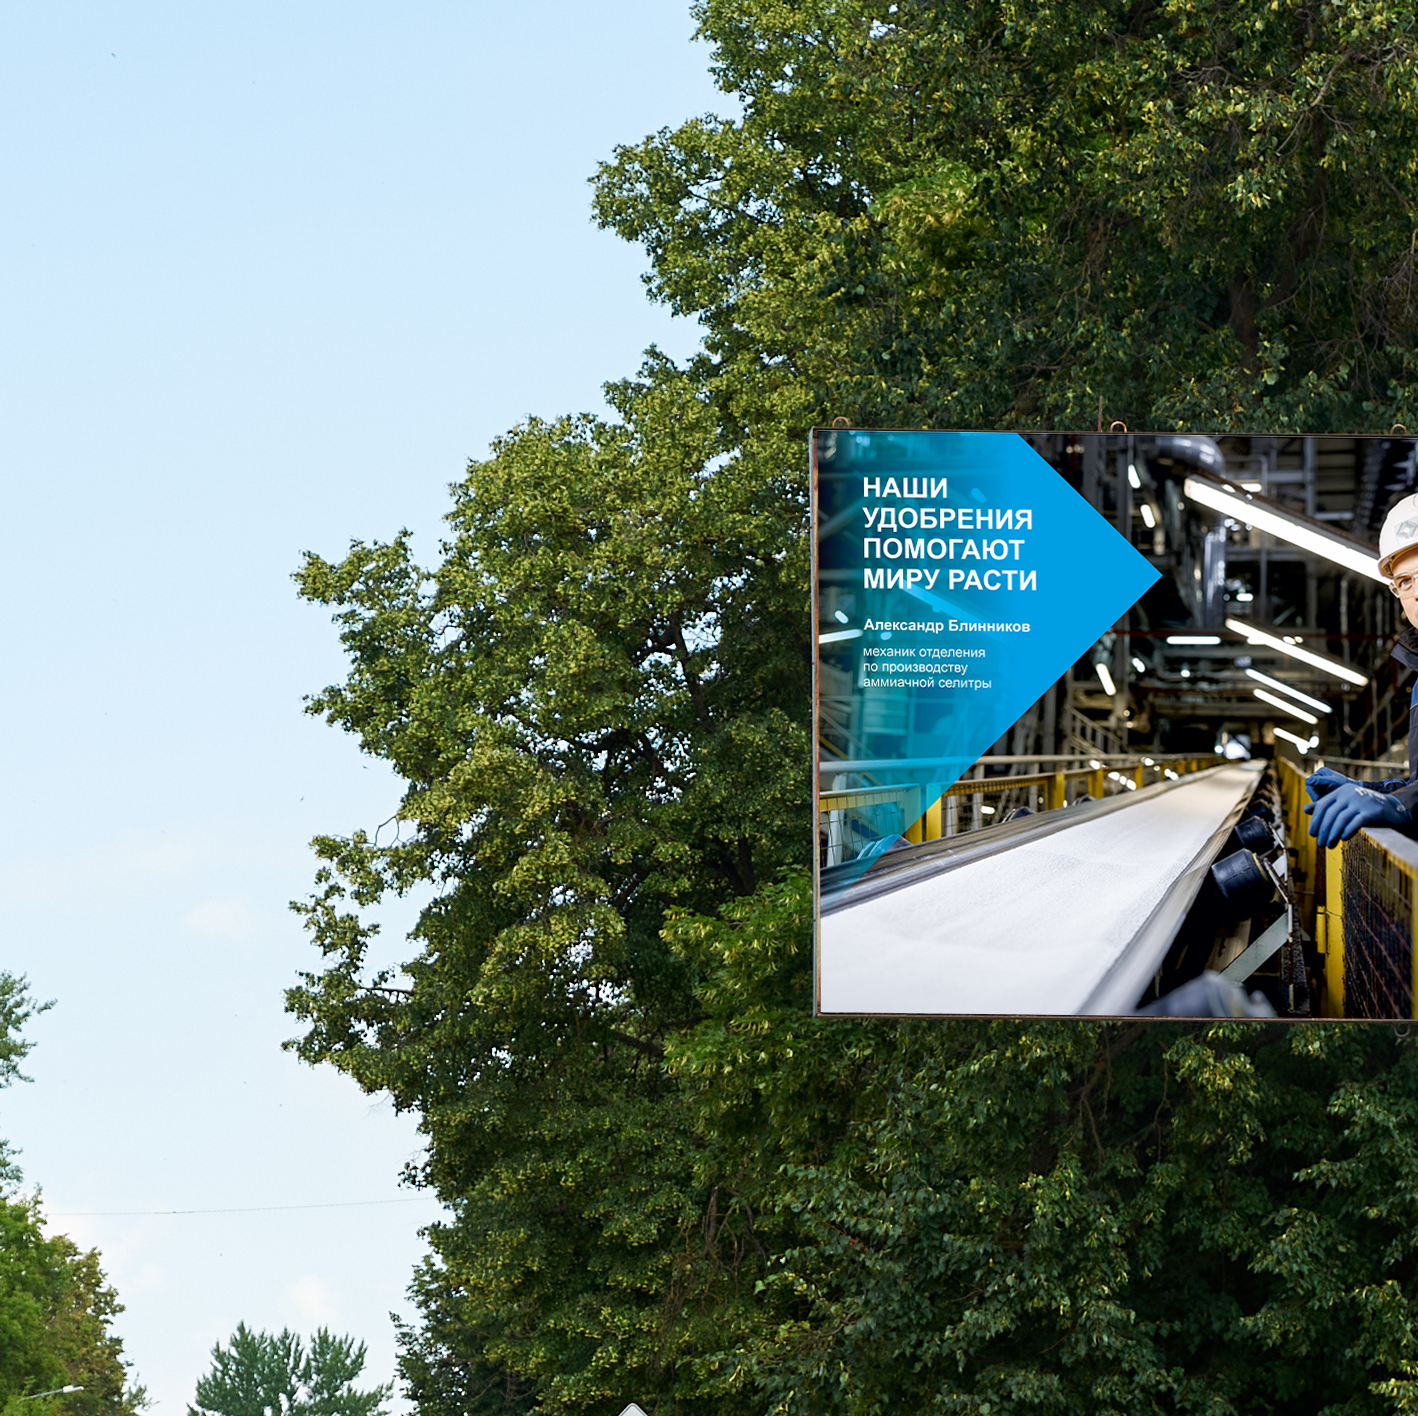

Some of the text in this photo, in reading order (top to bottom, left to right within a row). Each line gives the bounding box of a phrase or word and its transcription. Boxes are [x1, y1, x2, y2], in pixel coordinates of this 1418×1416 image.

[863, 476, 948, 499] НАШИ
[862, 507, 1033, 533] УДОБРЕНИЯ
[863, 537, 1026, 561] ПОМОГАЮТ
[863, 568, 1038, 591] МИРУ РАСТИ
[863, 618, 1031, 635] Александр Блинников
[863, 647, 986, 659] механик отделения
[863, 662, 969, 676] по производству
[862, 676, 992, 692] аммиачной селитры
